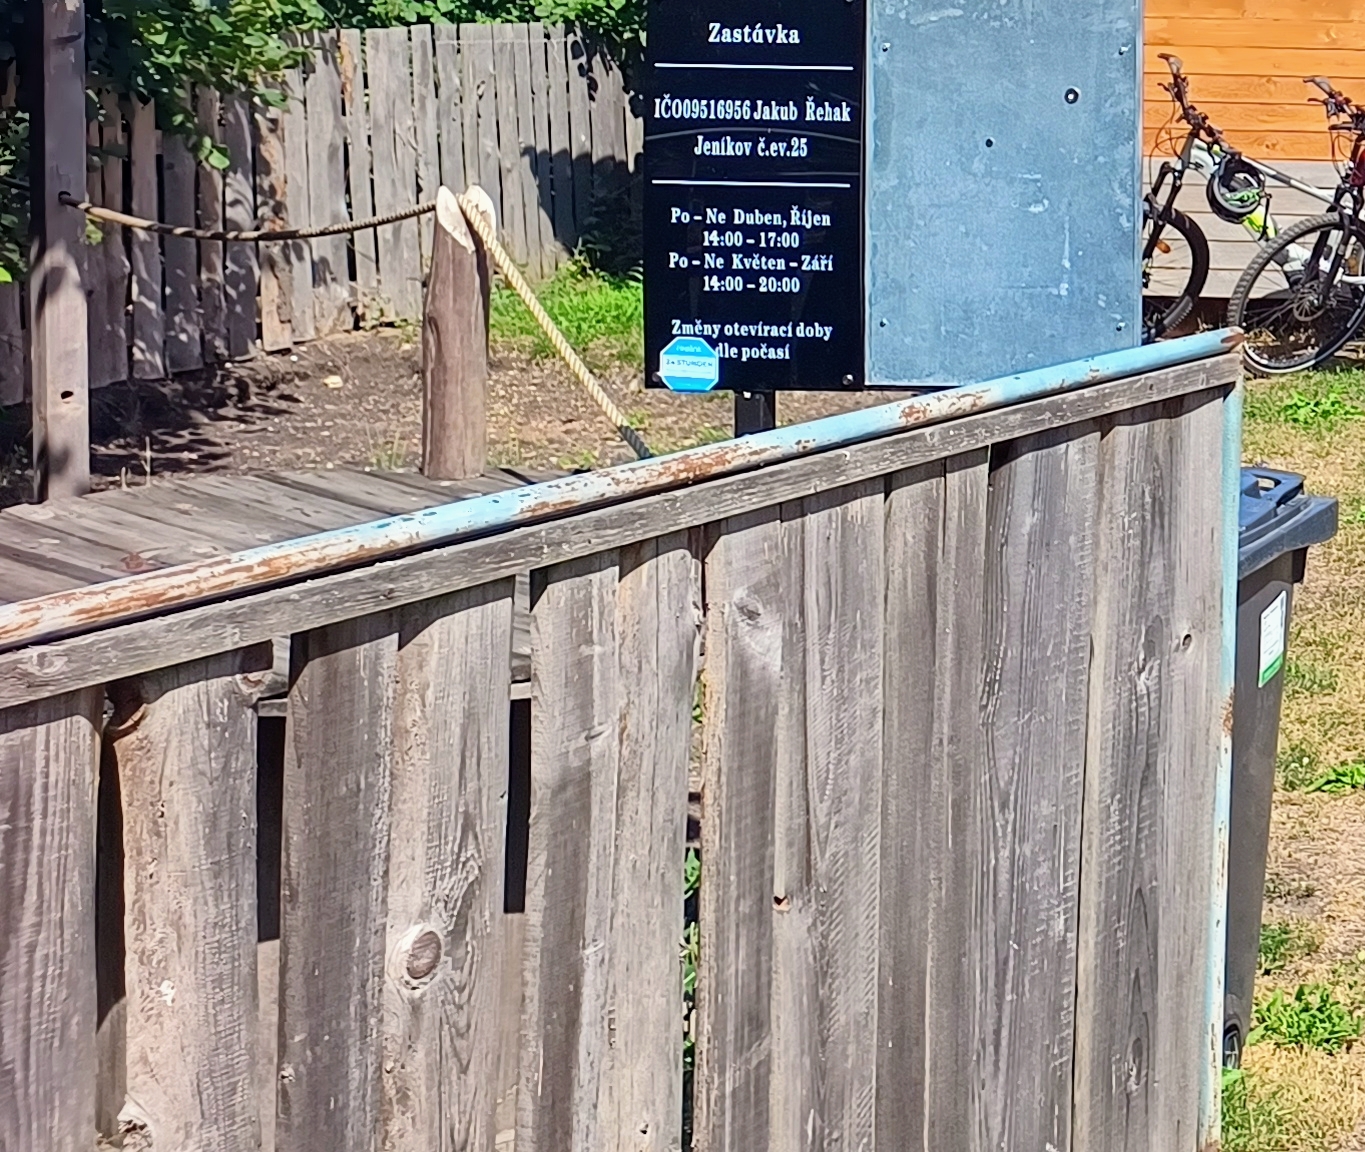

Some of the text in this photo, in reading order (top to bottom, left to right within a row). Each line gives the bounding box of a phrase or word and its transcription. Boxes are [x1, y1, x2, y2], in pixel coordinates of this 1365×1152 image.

[708, 22, 801, 44] Zastávka
[753, 100, 798, 121] Jakub
[694, 135, 808, 157] Jeníkov č.ev.25
[671, 207, 691, 223] Po
[705, 208, 726, 224] Ne
[733, 208, 787, 228] Duben,
[790, 205, 831, 229] Říjen
[703, 230, 743, 247] 14:00
[759, 232, 800, 248] 17:00
[669, 252, 689, 268] Po
[704, 253, 724, 269] Ne
[731, 253, 786, 271] Květen
[801, 254, 834, 271] Září
[703, 275, 743, 291] 14:00
[759, 277, 800, 293] 20:00
[671, 319, 833, 341] Změny otevírací doby
[741, 344, 790, 361] počasí
